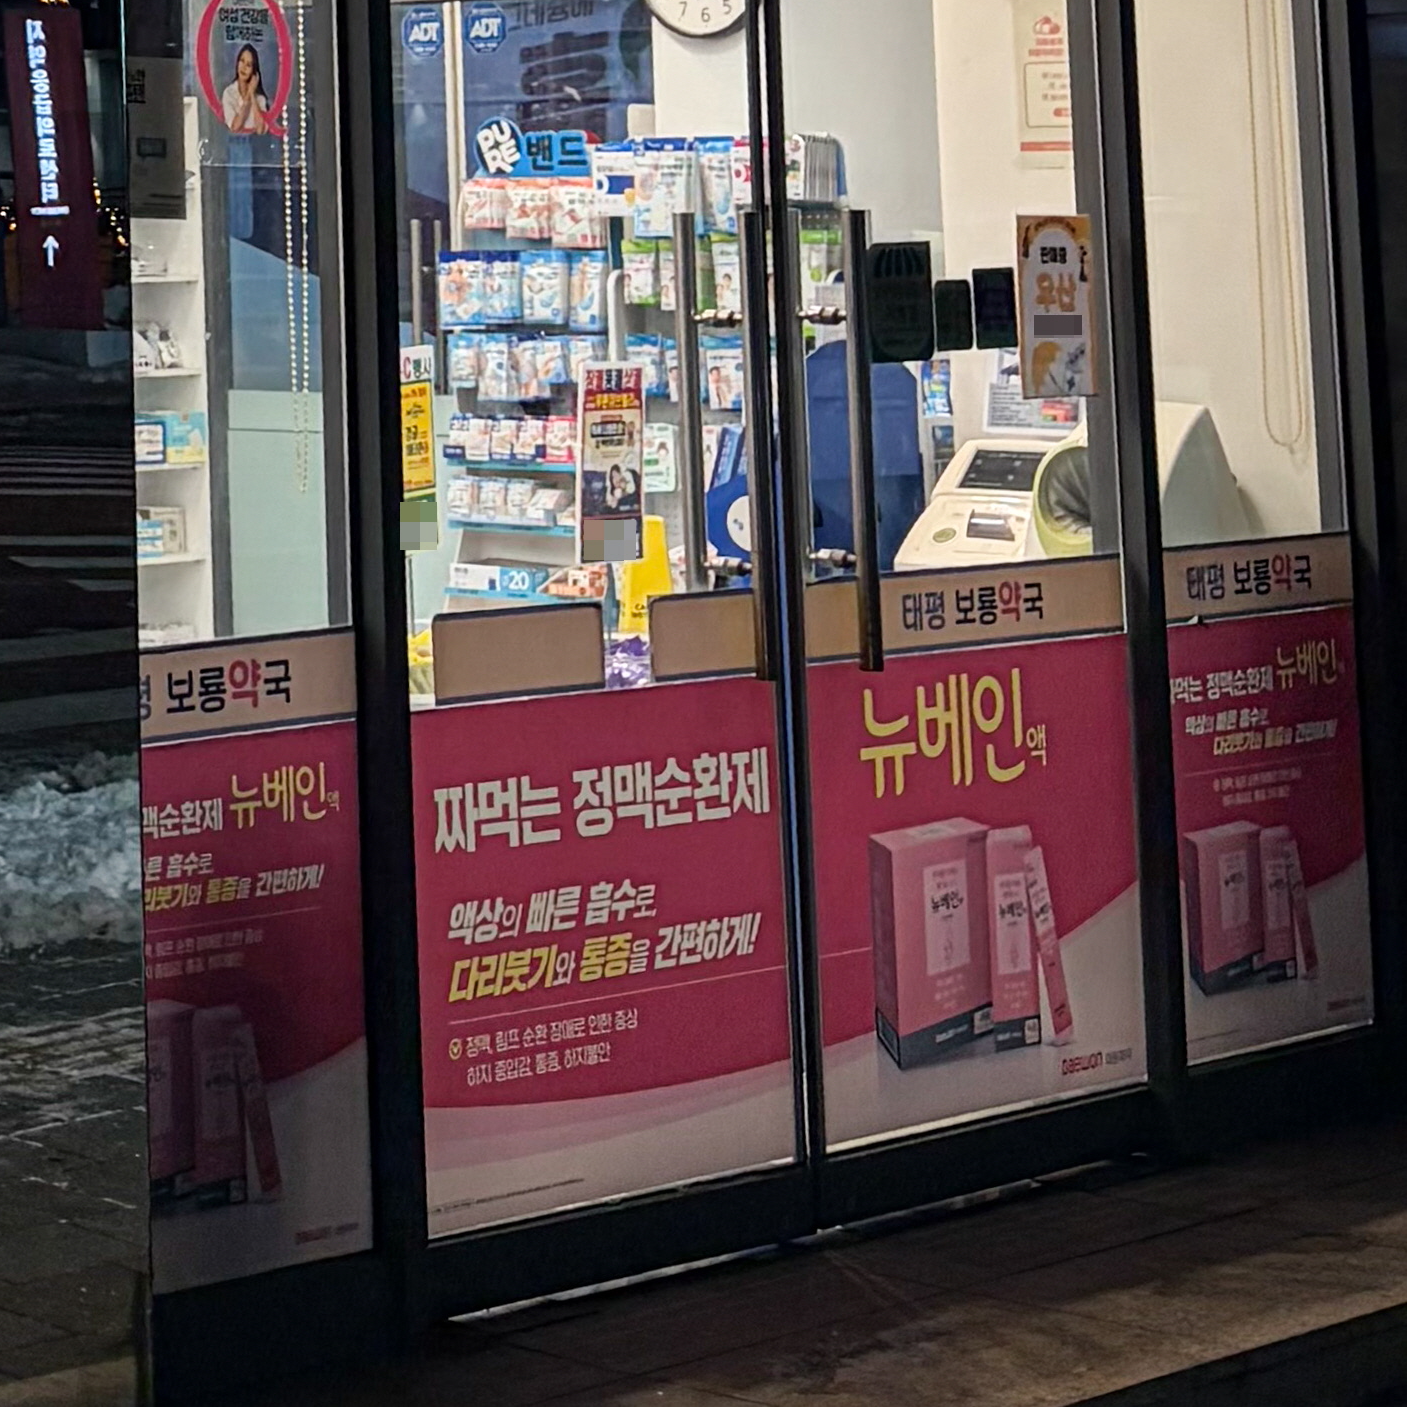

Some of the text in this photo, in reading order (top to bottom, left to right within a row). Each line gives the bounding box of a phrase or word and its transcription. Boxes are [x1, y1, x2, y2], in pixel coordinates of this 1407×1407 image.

[679, 2, 688, 18] 7
[700, 7, 711, 23] 6
[723, 0, 733, 15] 5
[409, 22, 441, 42] ADT
[469, 17, 501, 39] ADT
[526, 134, 588, 171] 밴드
[1186, 553, 1313, 600] 태평 보룡약국
[902, 580, 1045, 632] 태평 보룡약국
[166, 657, 293, 715] 보룡약국
[1205, 664, 1275, 701] 정맥순환제
[433, 746, 772, 854] 짜먹는 정맥순환제
[204, 862, 327, 905] 통증을 간편하게!
[447, 895, 523, 945] 액상의
[526, 888, 583, 933] 빠른
[447, 912, 761, 1004] 다리붓기와 통증을 간편하게!
[495, 1027, 521, 1053] 림프
[522, 1024, 549, 1049] 순환
[549, 1018, 587, 1044] 장애로
[587, 1013, 615, 1039] 인한
[615, 1008, 640, 1033] 증상
[466, 1061, 493, 1087] 하지
